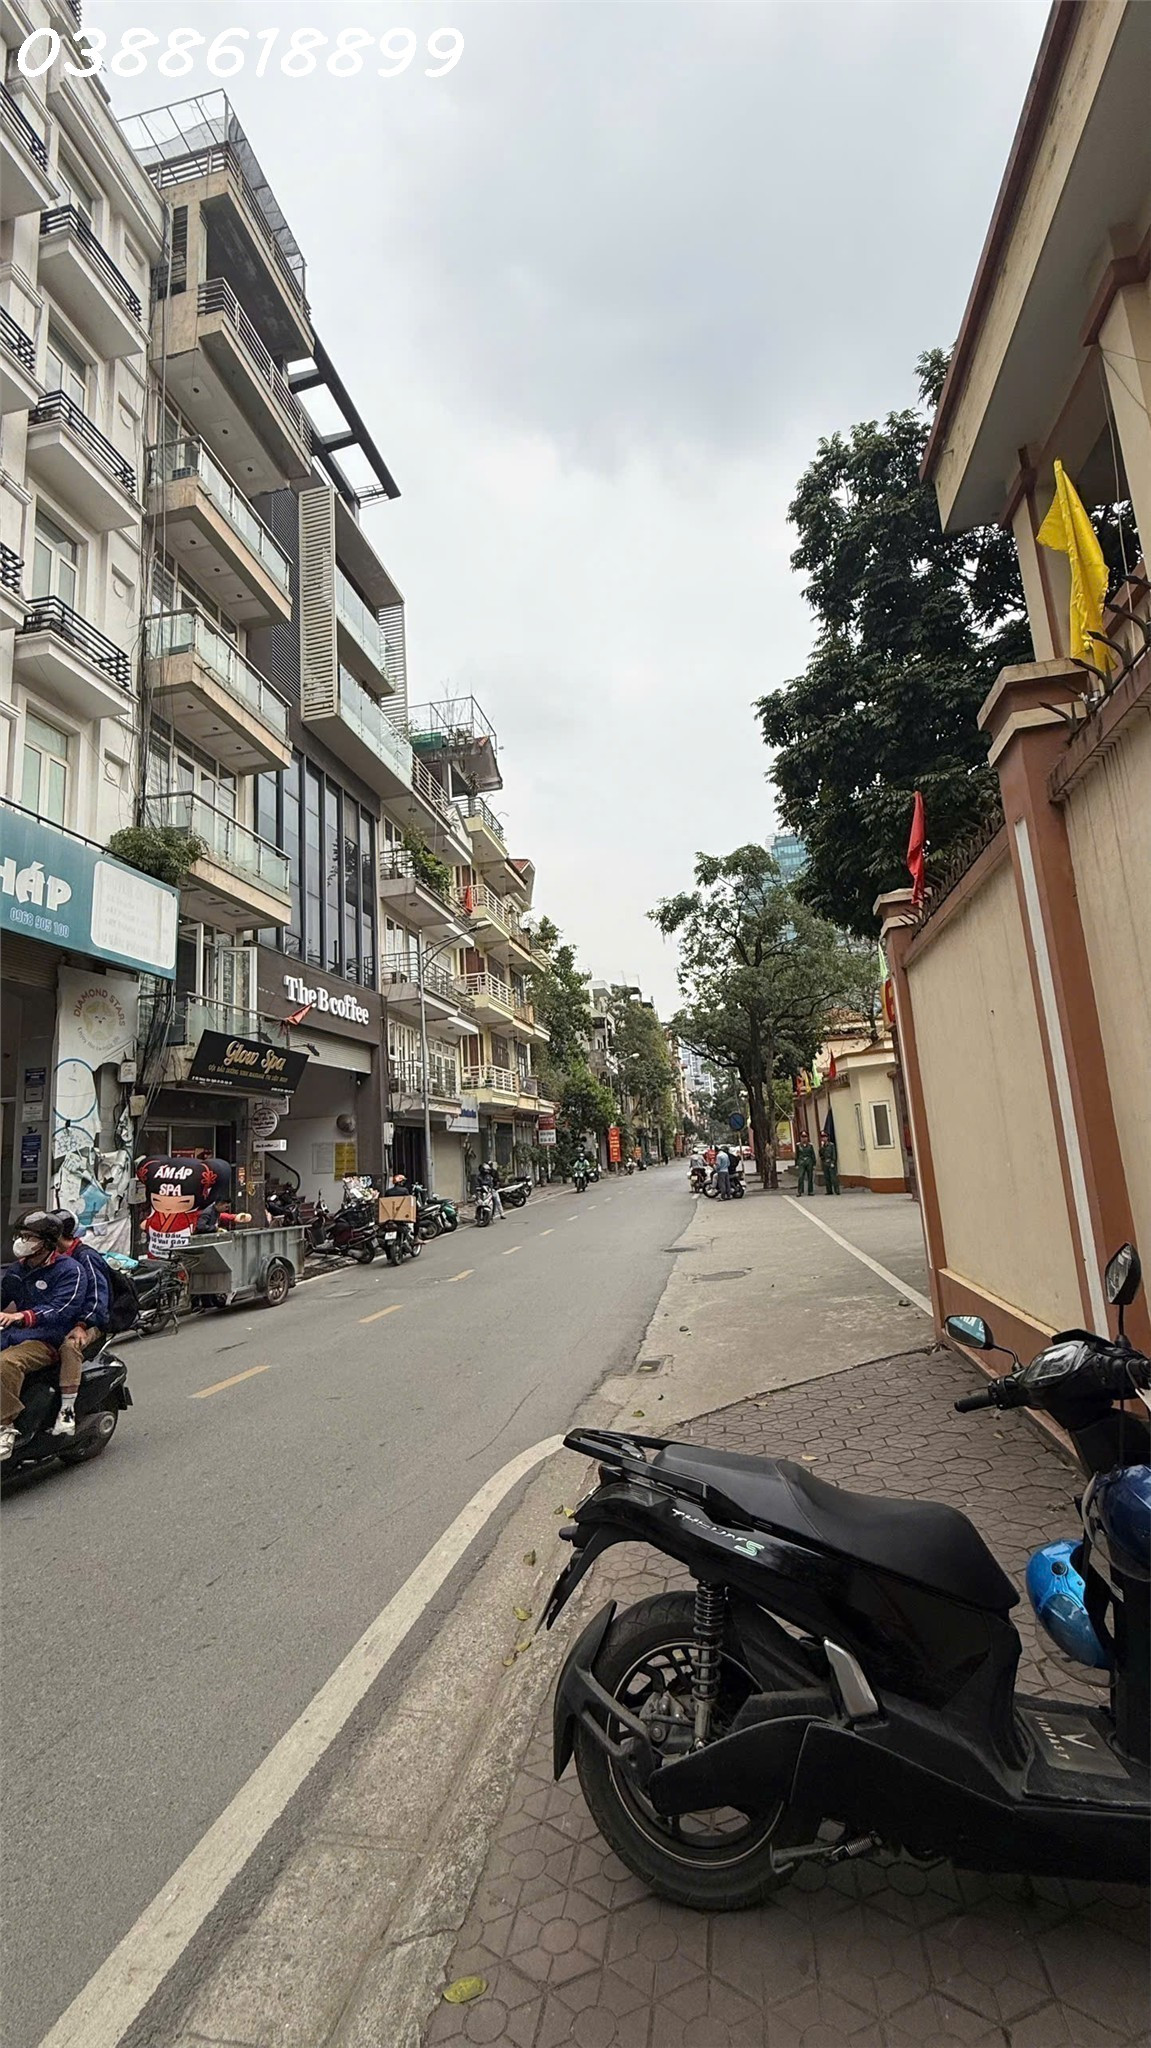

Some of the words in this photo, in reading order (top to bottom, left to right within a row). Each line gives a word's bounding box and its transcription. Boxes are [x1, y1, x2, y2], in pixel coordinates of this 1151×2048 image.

[10, 907, 33, 927] 0968
[35, 914, 52, 931] 905
[54, 922, 70, 939] 100
[73, 988, 108, 1018] DIAMOND
[109, 995, 126, 1027] STARS
[284, 975, 317, 1008] The
[223, 1040, 260, 1066] Glow
[261, 1049, 286, 1074] Spa
[159, 1183, 182, 1196] SPA
